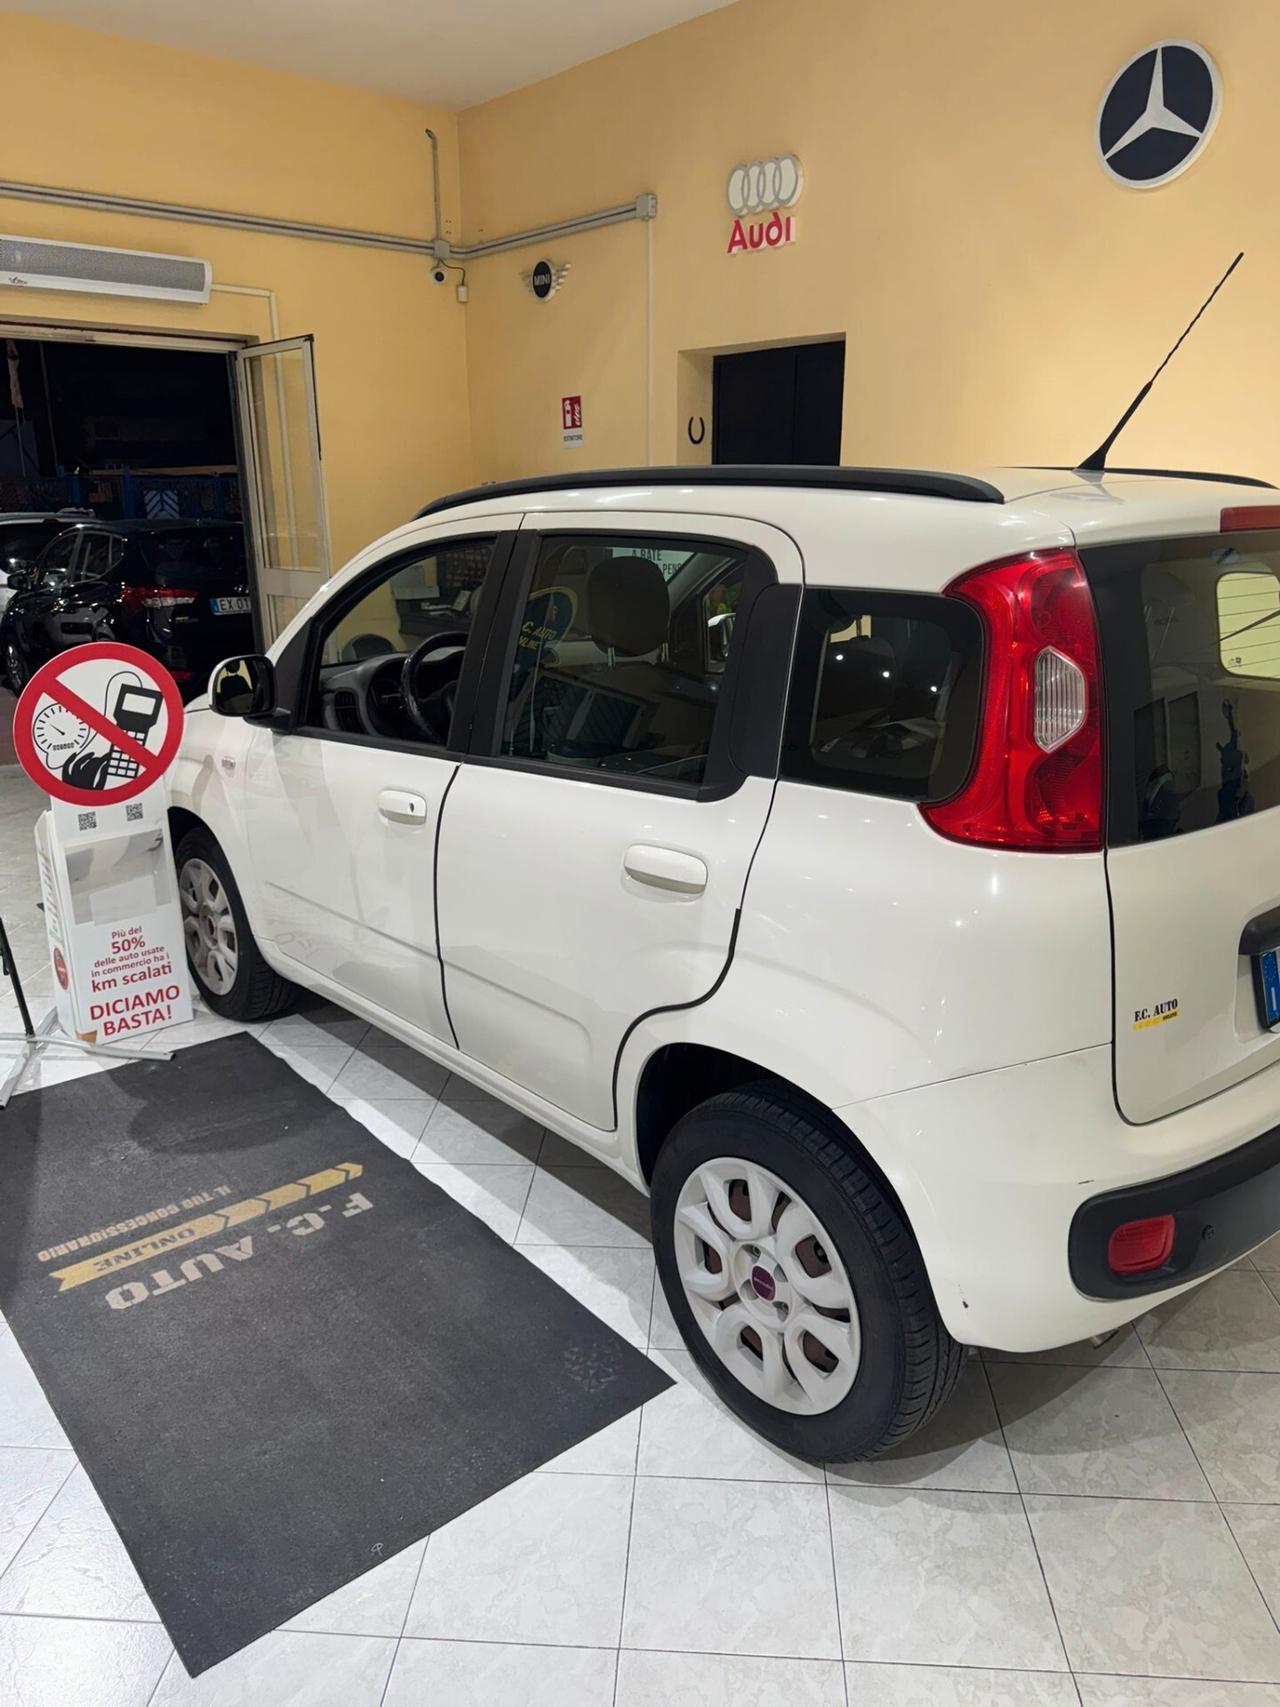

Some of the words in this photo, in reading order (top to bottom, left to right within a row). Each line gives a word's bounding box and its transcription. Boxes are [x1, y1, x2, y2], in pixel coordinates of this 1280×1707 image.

[727, 211, 791, 254] Audi
[534, 272, 551, 286] MINI
[111, 929, 126, 939] Più
[128, 925, 142, 936] del
[111, 935, 146, 955] 50%
[91, 970, 100, 978] in
[102, 957, 152, 976] commercio
[153, 954, 165, 963] ha
[94, 957, 117, 968] delle
[118, 952, 139, 962] auto
[141, 945, 165, 956] usate
[91, 979, 117, 993] km
[122, 961, 172, 985] scalati
[89, 985, 180, 1021] DICIAMO
[1153, 998, 1178, 1016] AUTO
[103, 1004, 172, 1037] BASTA!
[37, 1204, 180, 1262] CONCESSIONARIO
[93, 1228, 195, 1272] ONLINE
[105, 1235, 253, 1310] AUTO
